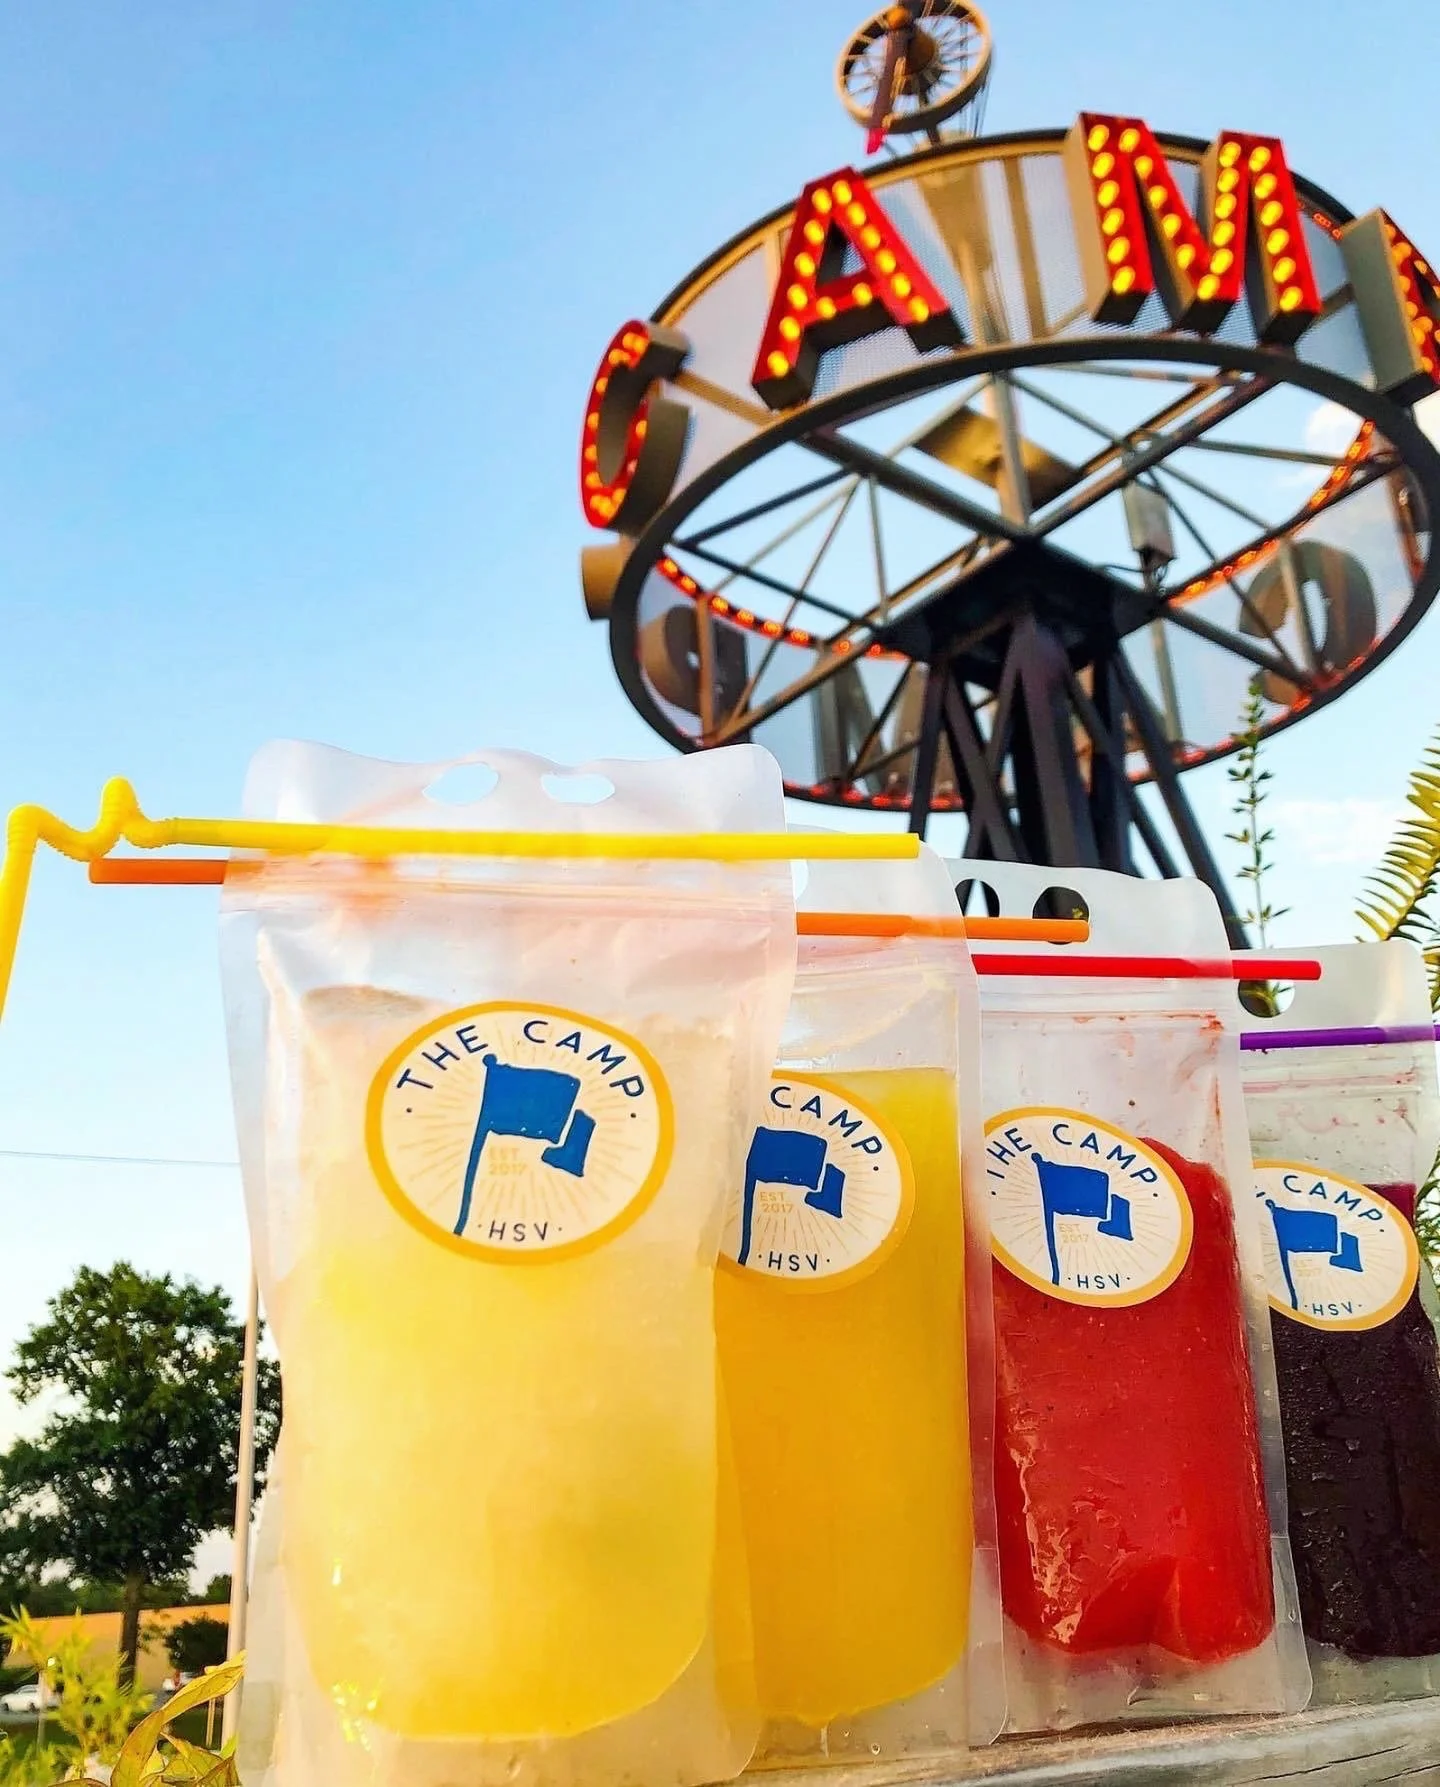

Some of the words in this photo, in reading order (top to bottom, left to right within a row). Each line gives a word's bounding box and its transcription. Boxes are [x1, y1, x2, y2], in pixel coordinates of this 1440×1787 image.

[396, 1024, 489, 1089] THE
[523, 1020, 645, 1098] CAMP
[770, 1086, 883, 1154] CAMP
[1052, 1123, 1158, 1183] CAMP
[759, 1191, 785, 1202] EST
[761, 1202, 793, 1213] 2017
[1283, 1174, 1383, 1221] CAMP
[488, 1220, 550, 1242] HSV
[767, 1250, 819, 1272] HSV
[1076, 1273, 1121, 1290] HSV
[1311, 1300, 1354, 1317] HSV
